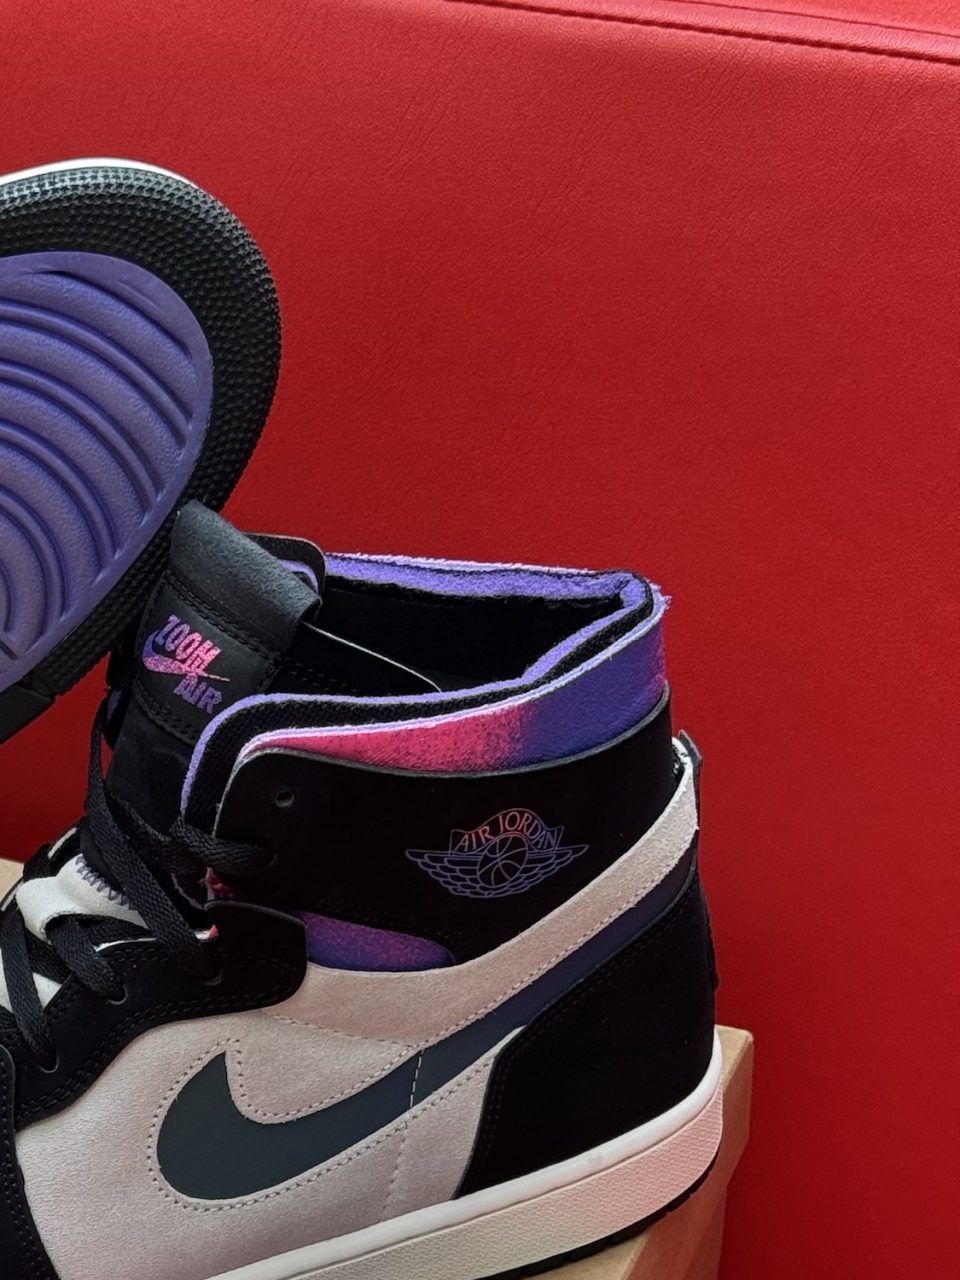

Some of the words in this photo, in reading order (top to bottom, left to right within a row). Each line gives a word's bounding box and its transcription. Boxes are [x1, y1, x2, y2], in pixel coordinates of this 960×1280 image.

[154, 614, 222, 675] ZOOM
[173, 673, 223, 714] AIR
[454, 825, 495, 852] AIR
[498, 811, 558, 850] JORDAN
